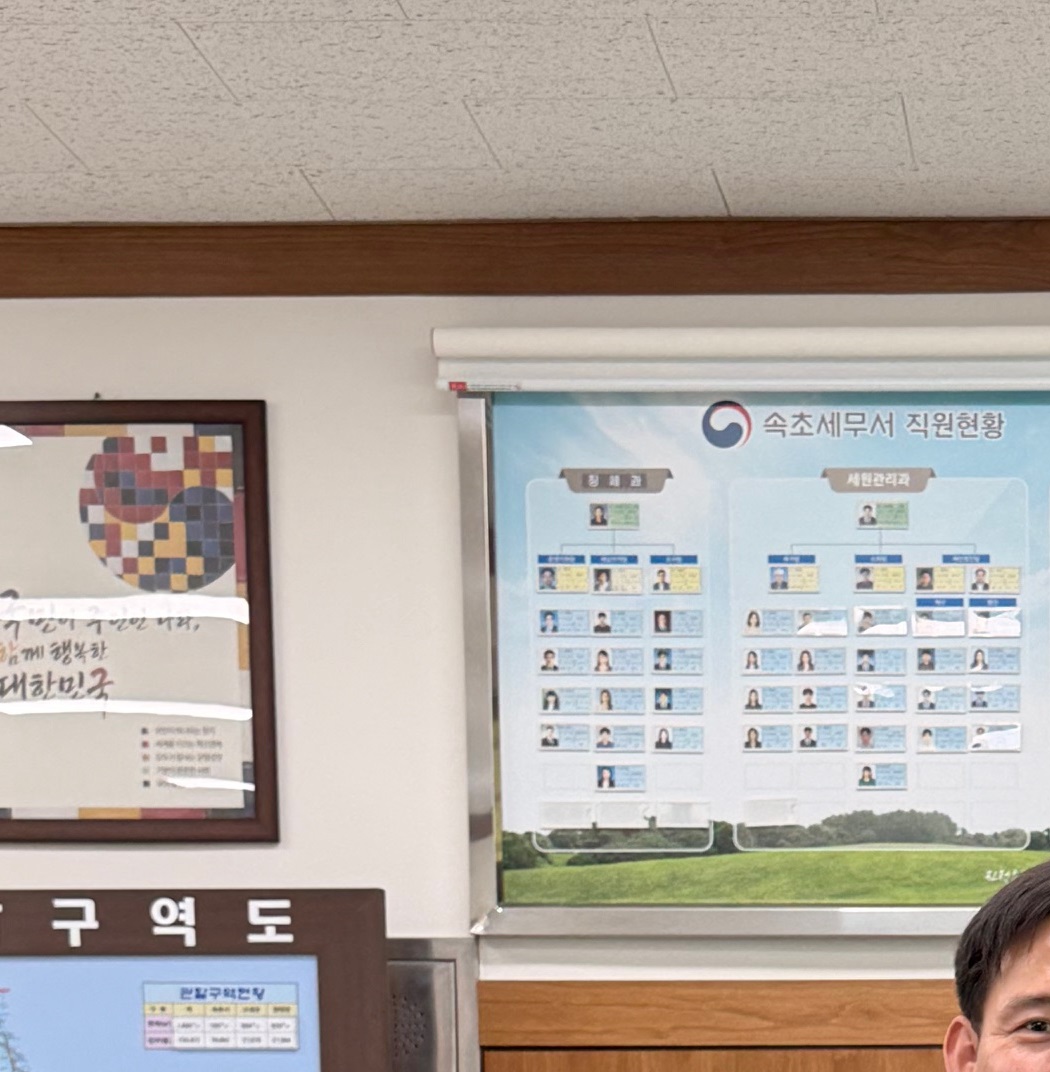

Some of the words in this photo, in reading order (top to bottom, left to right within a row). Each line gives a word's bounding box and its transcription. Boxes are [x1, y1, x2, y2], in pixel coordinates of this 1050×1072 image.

[763, 411, 895, 438] 속초세무서
[905, 411, 1005, 439] 직원현황
[50, 639, 108, 665] 행복한
[0, 667, 114, 701] 대한민국
